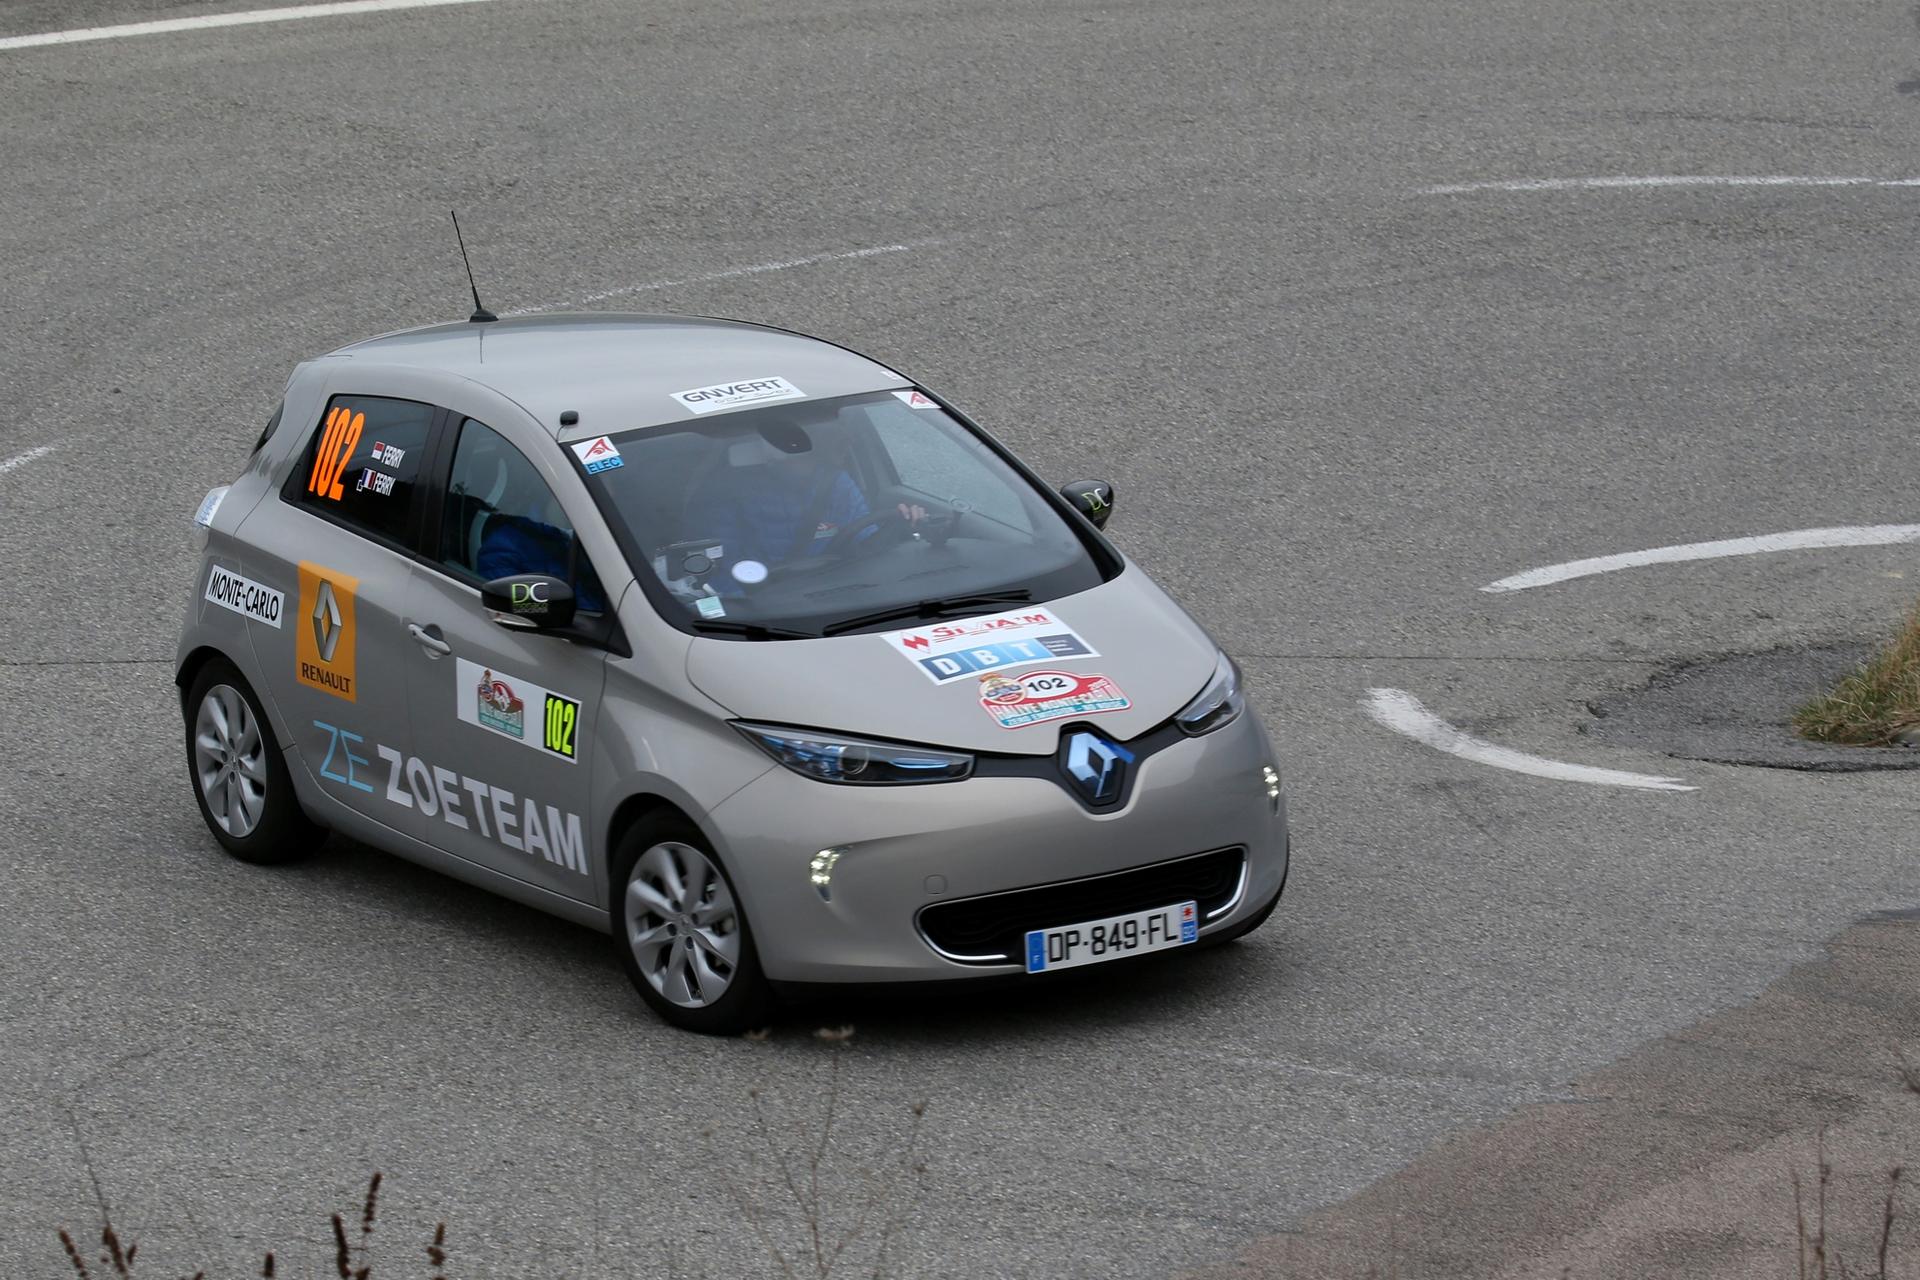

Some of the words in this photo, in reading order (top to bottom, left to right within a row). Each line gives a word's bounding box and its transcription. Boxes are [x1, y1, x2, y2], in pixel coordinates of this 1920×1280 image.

[683, 379, 783, 402] GNVERT
[308, 407, 365, 501] 102
[381, 445, 405, 469] FERRY
[587, 457, 620, 473] ELEC
[372, 472, 396, 496] FERRY
[208, 571, 279, 622] MONTE-CARLO
[511, 582, 549, 604] DC
[301, 662, 351, 693] RENAULT
[1027, 677, 1068, 693] 102
[546, 698, 575, 755] 102
[313, 720, 374, 792] ZE
[1032, 955, 1041, 964] F
